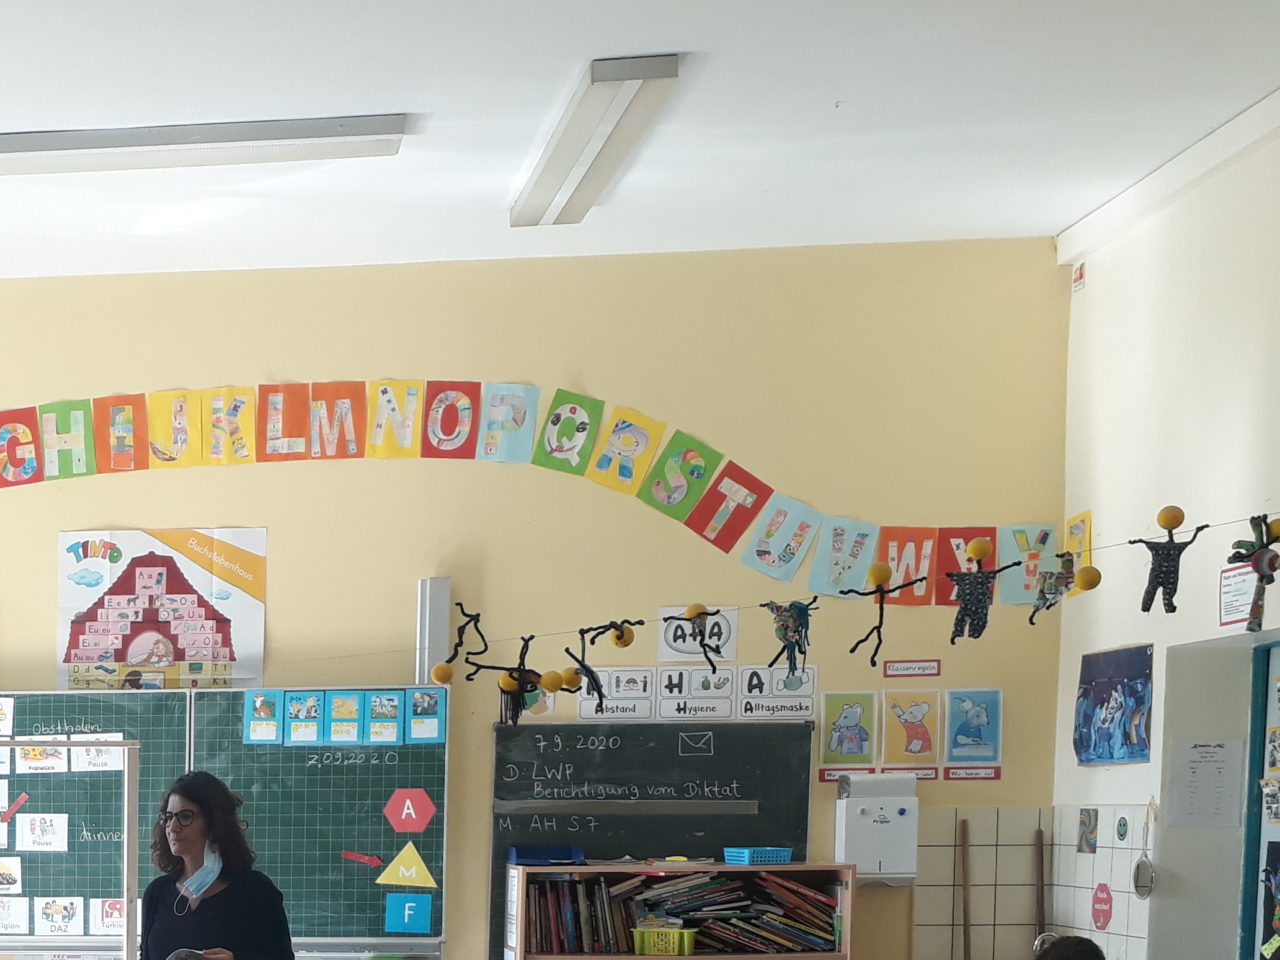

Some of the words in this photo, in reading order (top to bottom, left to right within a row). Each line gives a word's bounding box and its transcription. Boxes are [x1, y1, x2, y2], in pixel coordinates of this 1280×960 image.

[42, 410, 87, 474] H
[110, 405, 134, 470] I
[150, 396, 189, 463] J
[210, 394, 250, 458] K
[267, 393, 306, 454] L
[311, 398, 357, 457] M
[370, 385, 418, 447] N
[427, 390, 473, 450] O
[484, 392, 527, 455] P
[543, 403, 590, 468] Q
[595, 418, 649, 483] R
[651, 447, 706, 505] S
[702, 476, 757, 540] T
[755, 507, 812, 568] U
[831, 525, 869, 586] V
[887, 538, 934, 597] W
[66, 539, 122, 563] TINTO
[187, 537, 254, 581] Buchstabenhaus
[665, 672, 683, 694] H
[748, 671, 764, 694] A
[595, 702, 636, 715] Abstand
[675, 701, 717, 714] Hygiene
[744, 701, 810, 714] Alltagsmaske
[532, 761, 573, 780] LWP
[534, 781, 639, 800] Berichtigung
[647, 785, 677, 796] vom
[683, 780, 741, 798] Diktat
[401, 799, 416, 819] A
[80, 821, 124, 842] drinne
[529, 815, 557, 832] AH
[399, 866, 417, 878] M
[405, 903, 416, 923] F
[50, 925, 68, 933] DAZ
